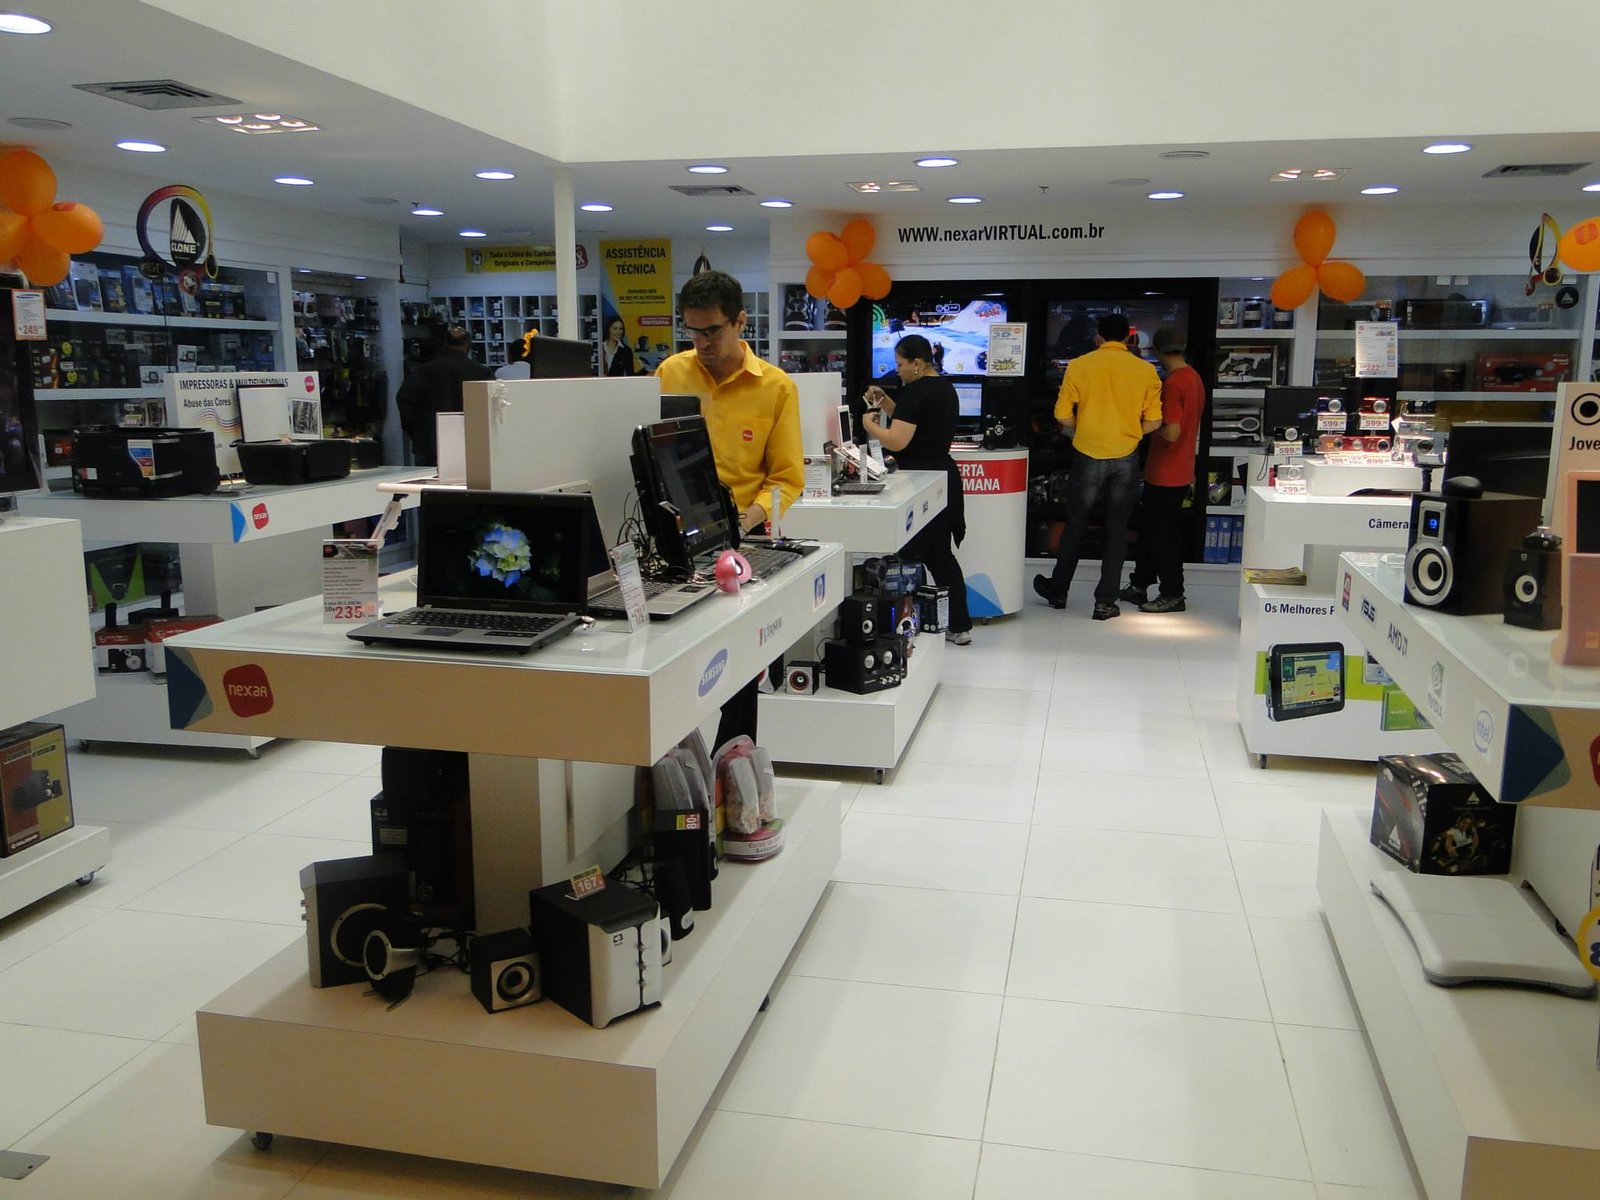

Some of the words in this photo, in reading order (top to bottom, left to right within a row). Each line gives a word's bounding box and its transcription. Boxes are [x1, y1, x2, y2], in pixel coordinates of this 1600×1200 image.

[171, 242, 197, 254] CLONE
[605, 245, 667, 259] ASSISTÊNCIA
[616, 261, 656, 275] TÉCNICA
[179, 378, 229, 390] IMPRESSORAS
[229, 379, 235, 388] &
[183, 399, 202, 408] Abuse
[203, 398, 215, 407] das
[214, 398, 232, 407] Cores
[961, 478, 1001, 491] MANA
[1368, 518, 1409, 530] Câmera
[334, 605, 363, 619] 235
[1264, 602, 1277, 613] Os
[1279, 603, 1327, 615] Melhores
[1387, 623, 1403, 652] AMD
[577, 876, 597, 893] 167
